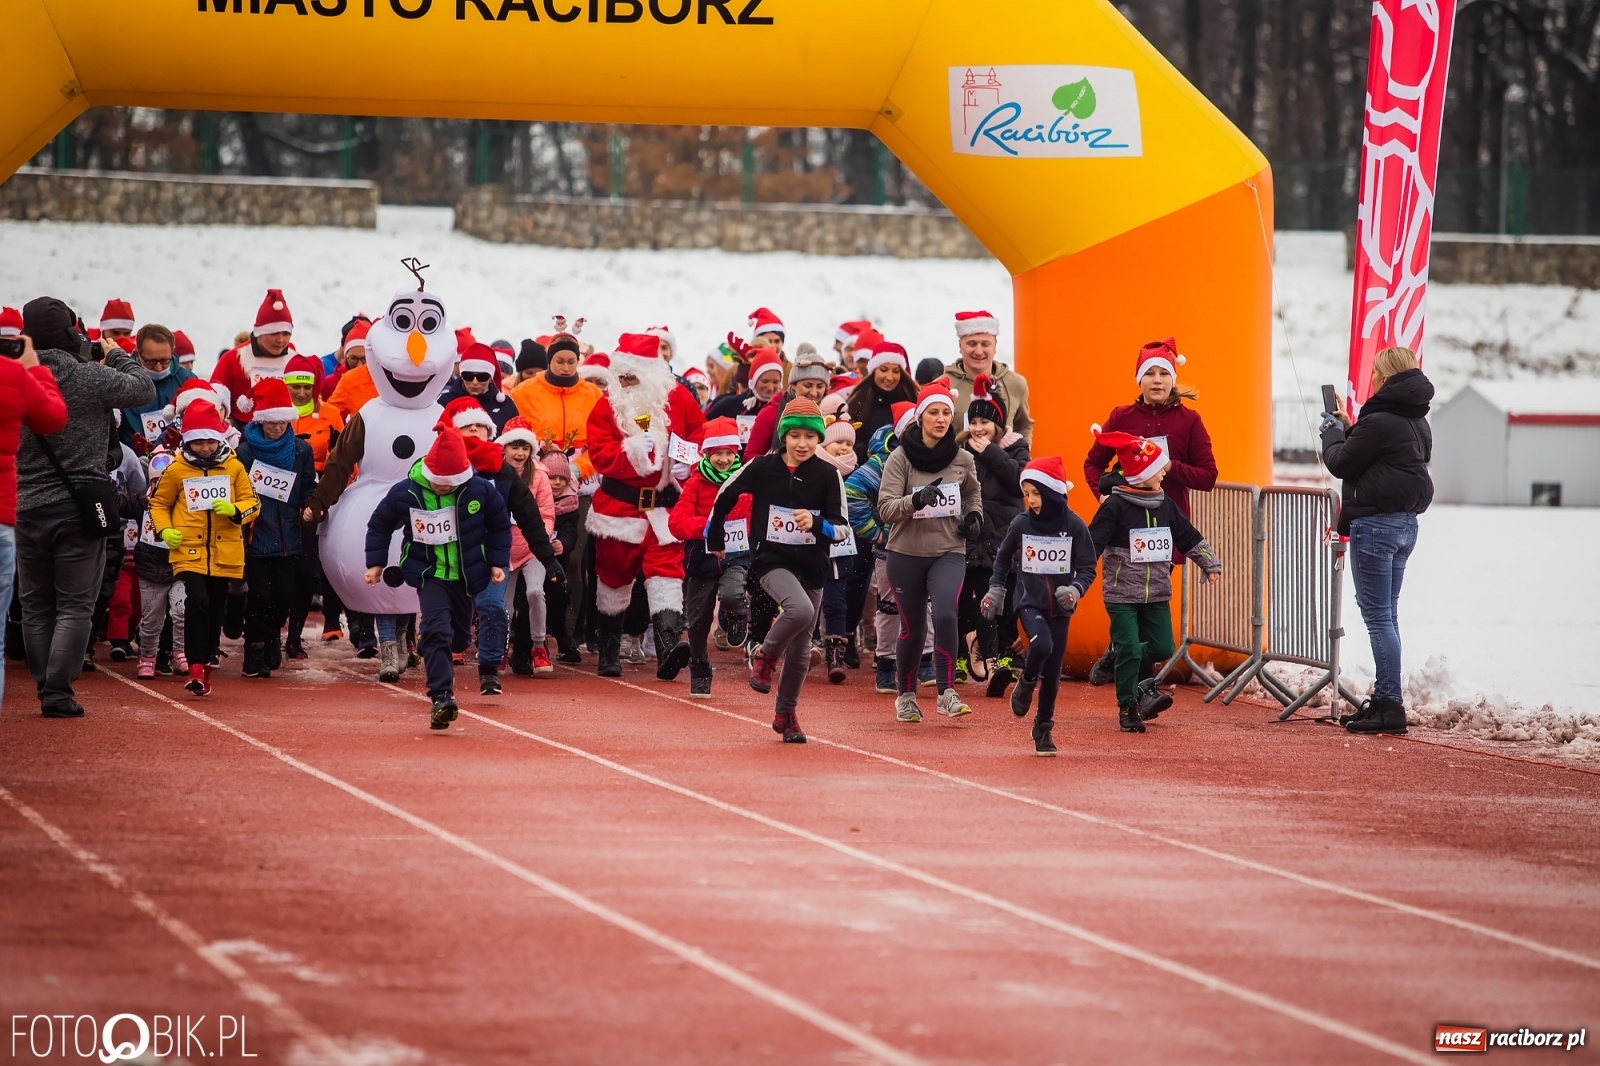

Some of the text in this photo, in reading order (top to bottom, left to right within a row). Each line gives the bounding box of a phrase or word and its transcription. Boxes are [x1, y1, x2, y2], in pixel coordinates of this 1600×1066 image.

[970, 102, 1130, 155] Racibórz
[263, 475, 289, 491] 022
[201, 487, 227, 499] 008
[426, 520, 451, 534] 016
[1147, 538, 1170, 551] 038
[1037, 549, 1067, 562] 002
